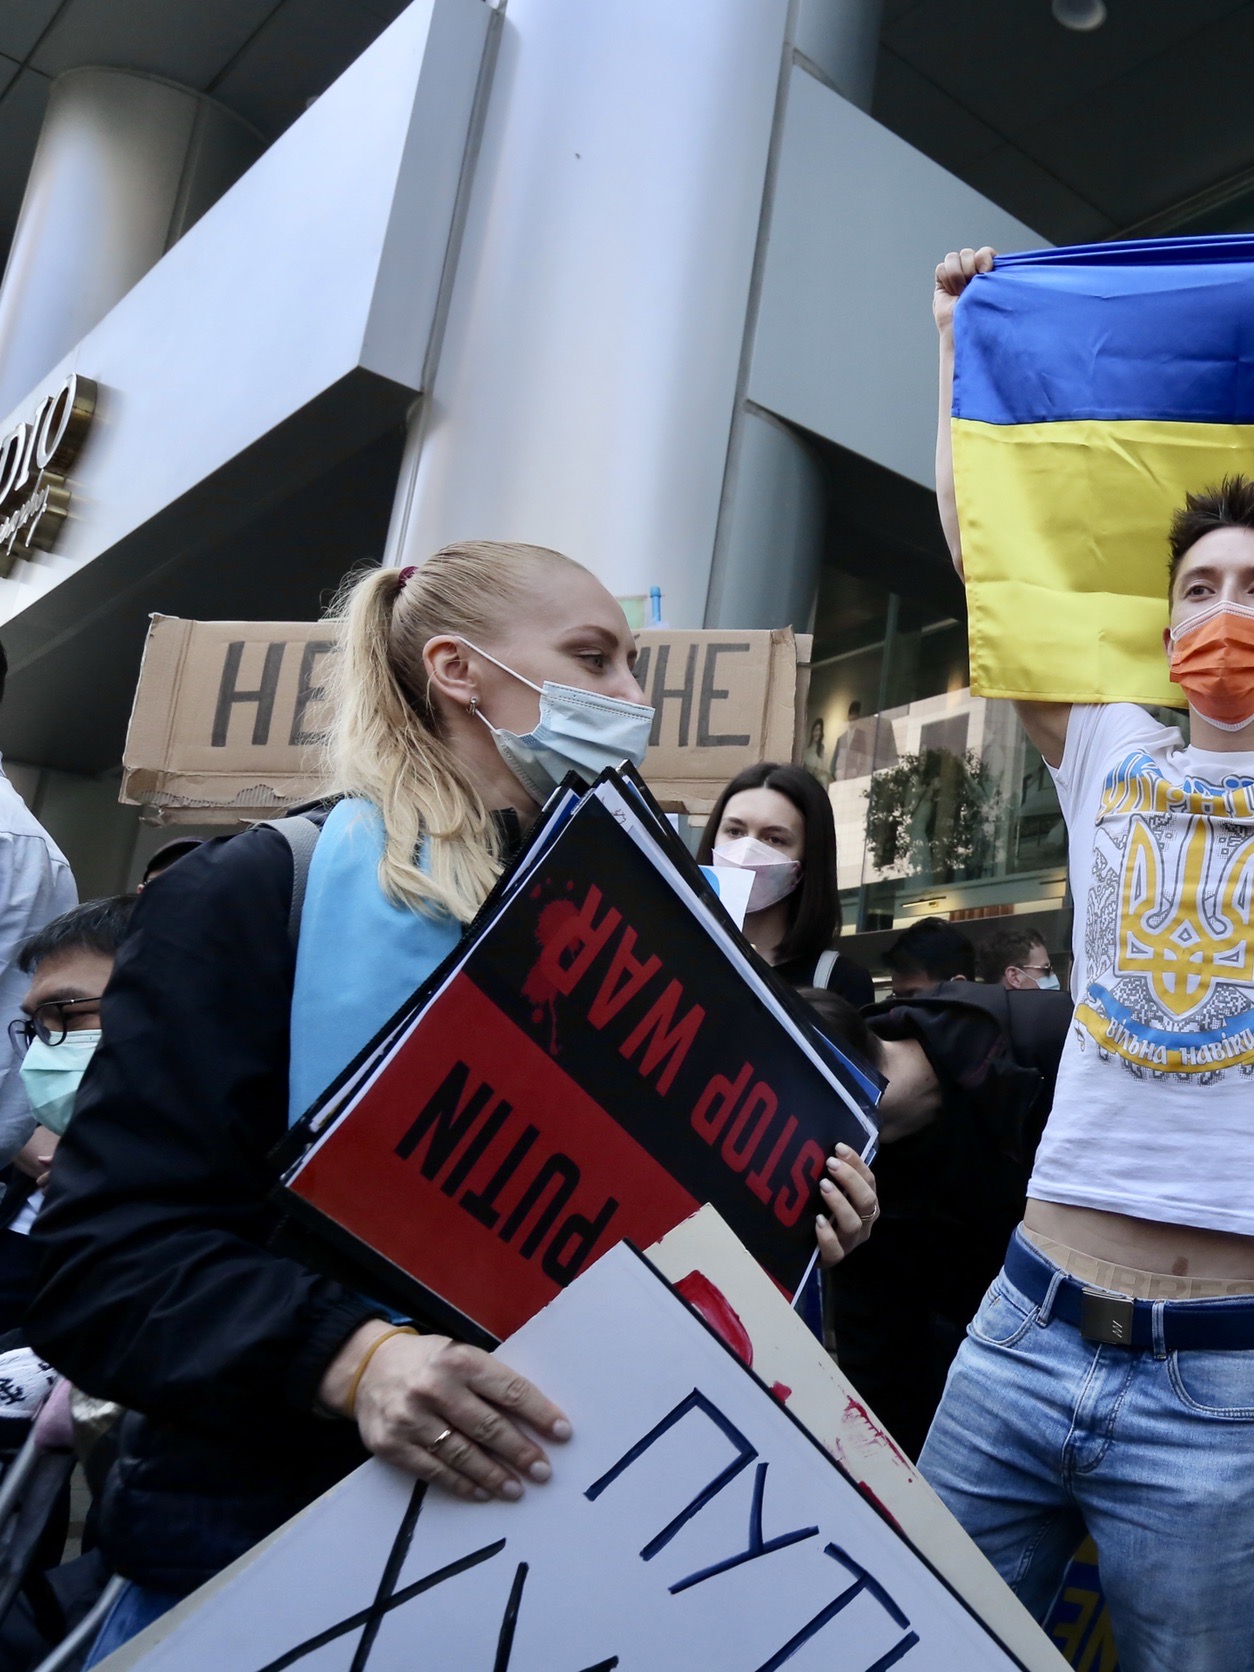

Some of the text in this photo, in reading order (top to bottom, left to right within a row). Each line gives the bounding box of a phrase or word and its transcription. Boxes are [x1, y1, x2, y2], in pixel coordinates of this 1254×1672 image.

[210, 640, 346, 748] НЕ
[543, 882, 828, 1229] STOP WAR
[393, 1059, 621, 1289] PUTIN
